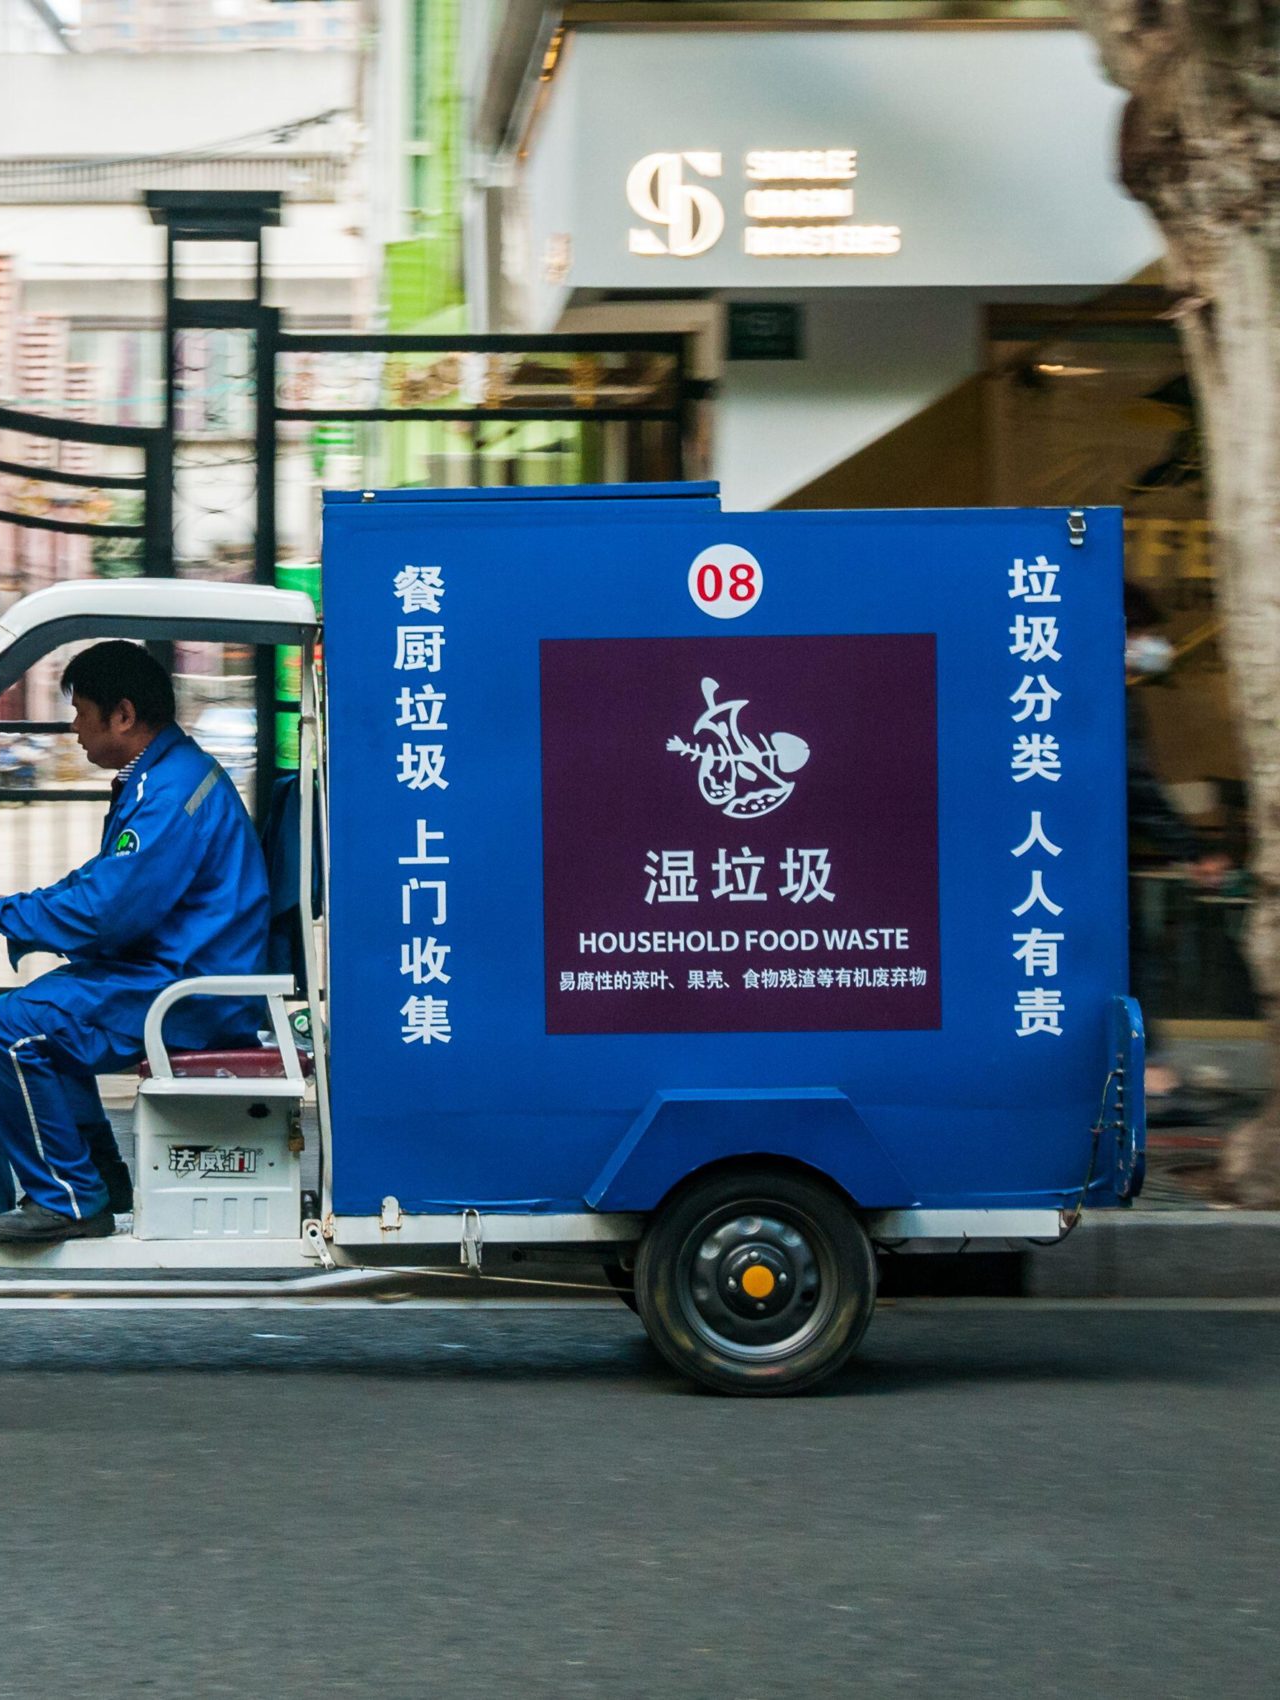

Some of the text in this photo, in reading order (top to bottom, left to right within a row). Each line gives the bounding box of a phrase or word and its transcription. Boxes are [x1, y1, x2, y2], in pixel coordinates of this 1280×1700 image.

[696, 562, 757, 603] 08
[393, 565, 452, 1044] 餐厨垃圾 上门收集
[1008, 555, 1065, 1037] 垃圾分类 人人有责
[643, 846, 836, 905] 湿垃圾
[579, 928, 910, 954] HOUSEHOLD FOOD WASTE
